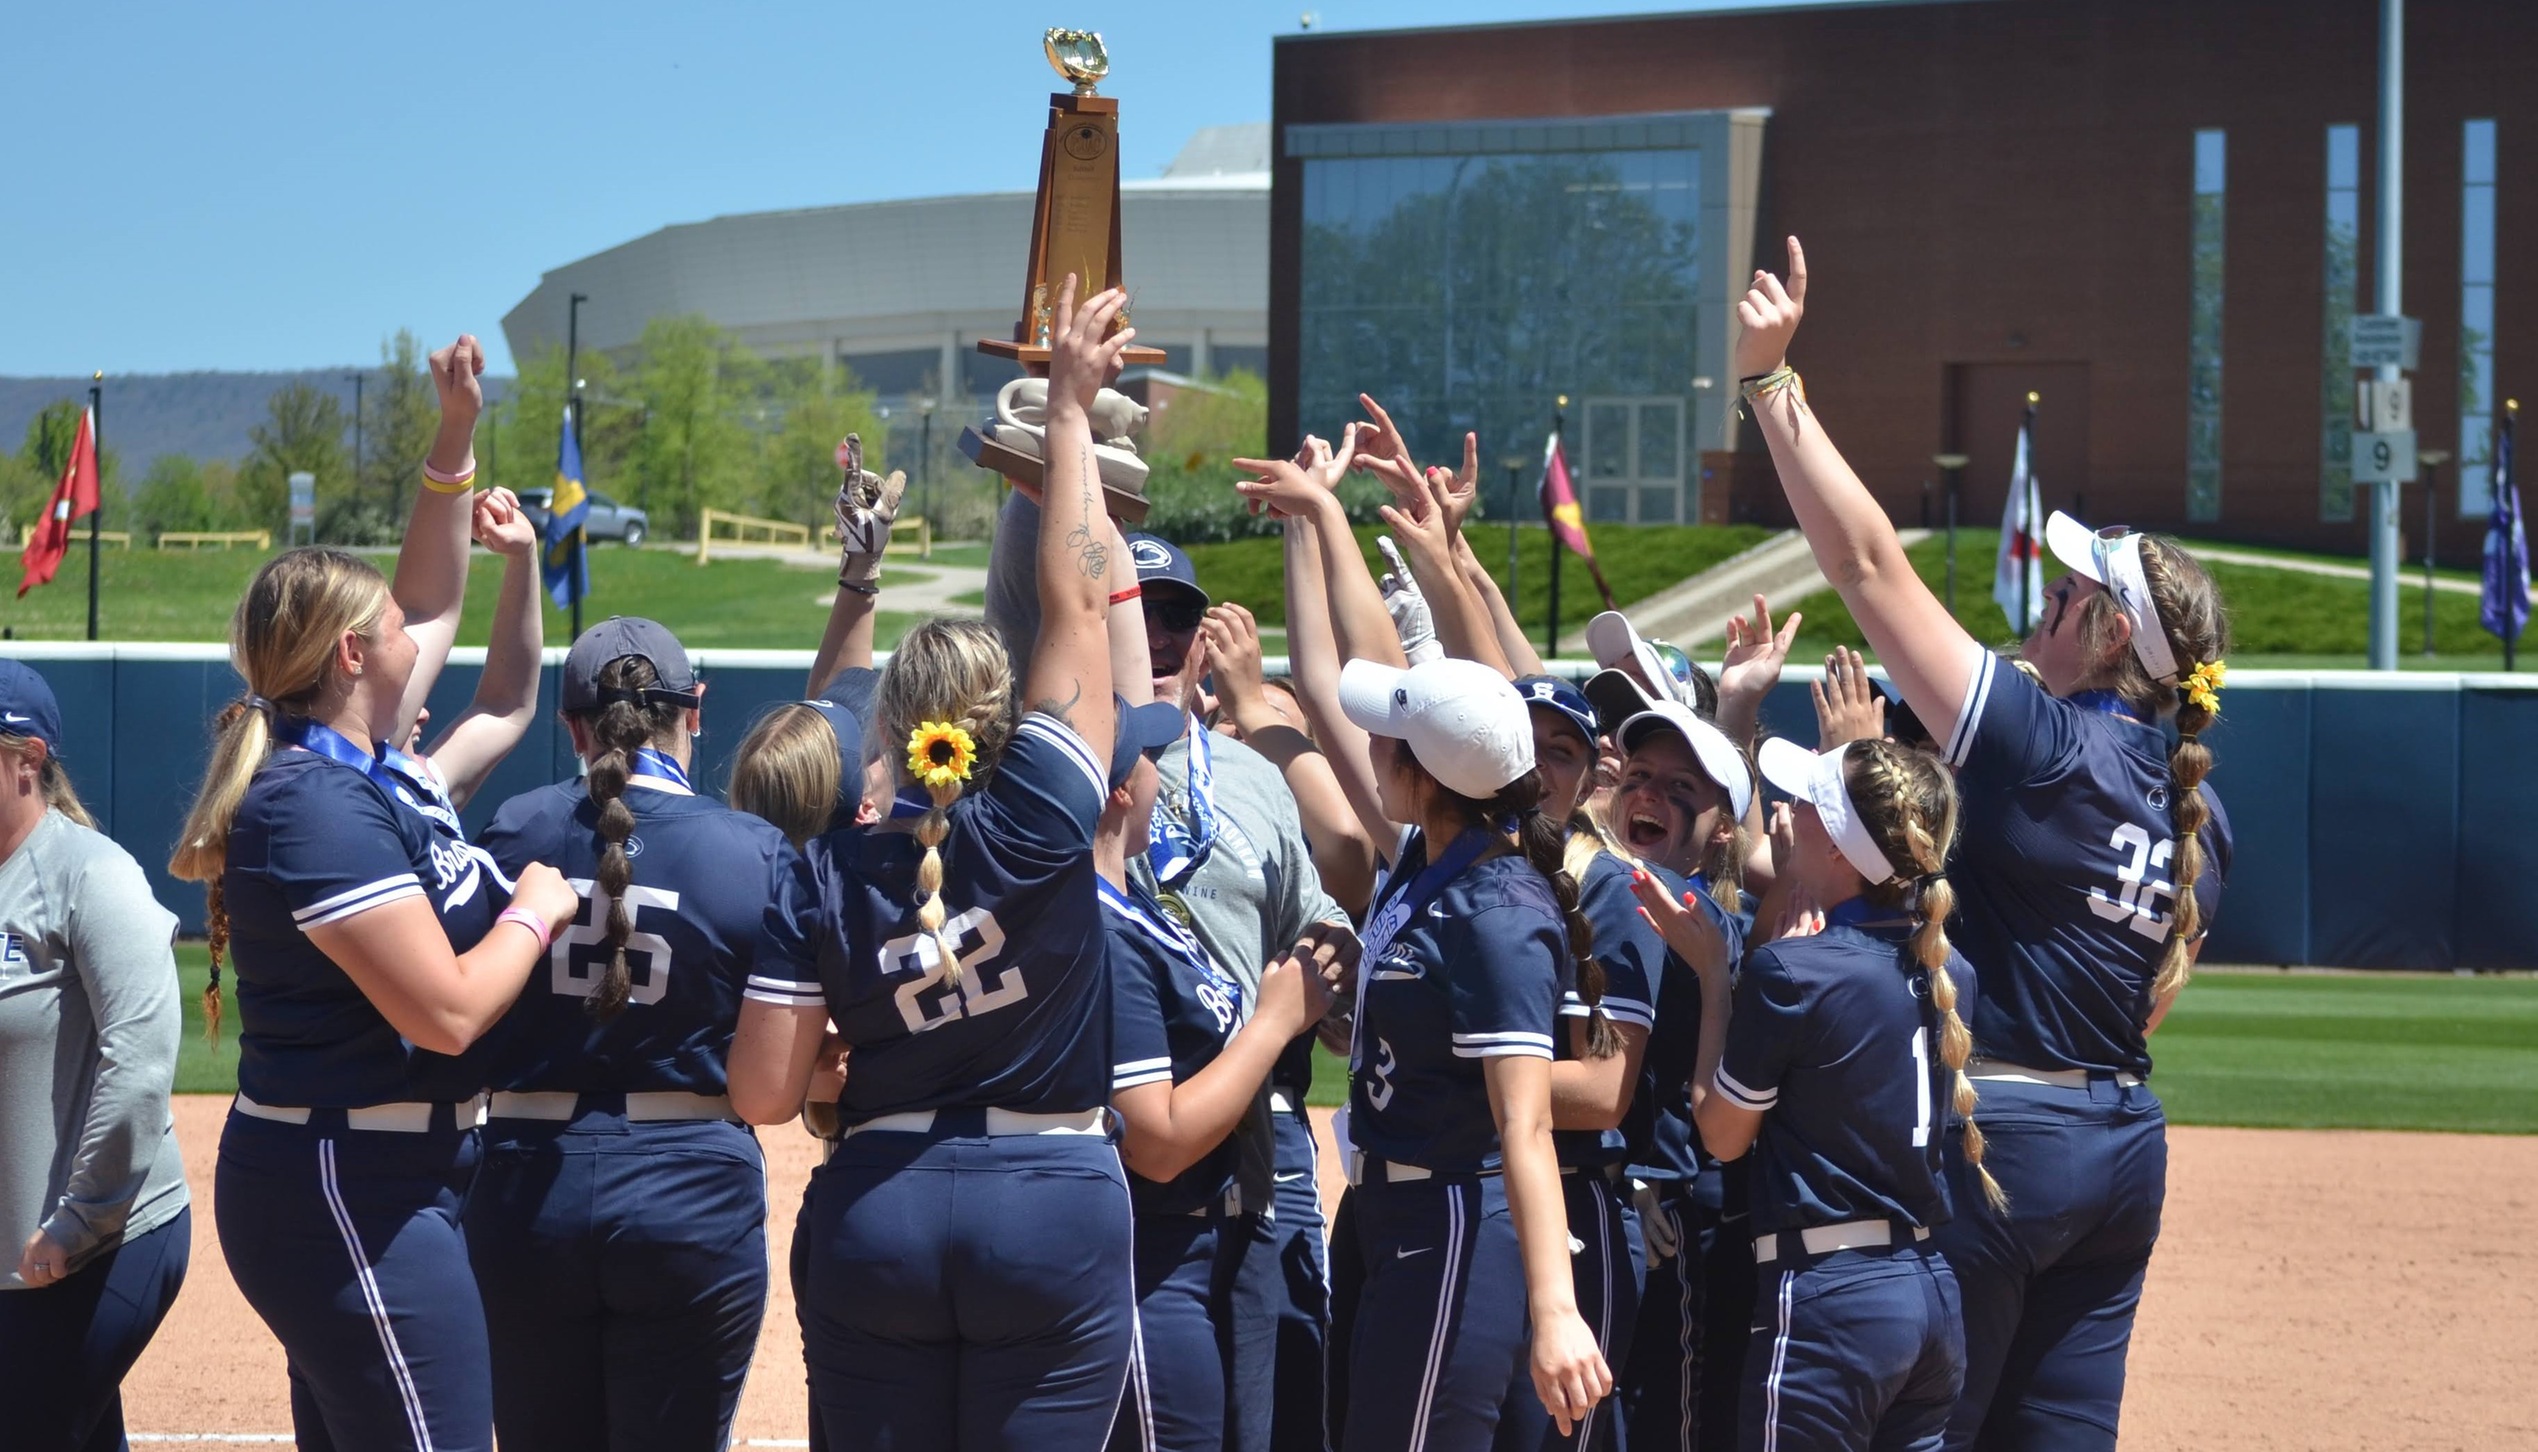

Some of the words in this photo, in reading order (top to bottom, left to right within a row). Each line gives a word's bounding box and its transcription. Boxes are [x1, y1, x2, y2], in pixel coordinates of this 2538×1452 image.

[2373, 441, 2391, 472] 9
[551, 877, 680, 1005] 25
[2086, 822, 2177, 943] 32
[878, 906, 1028, 1035] 22
[1366, 1037, 1396, 1112] 3
[1912, 1026, 1931, 1147] 1
